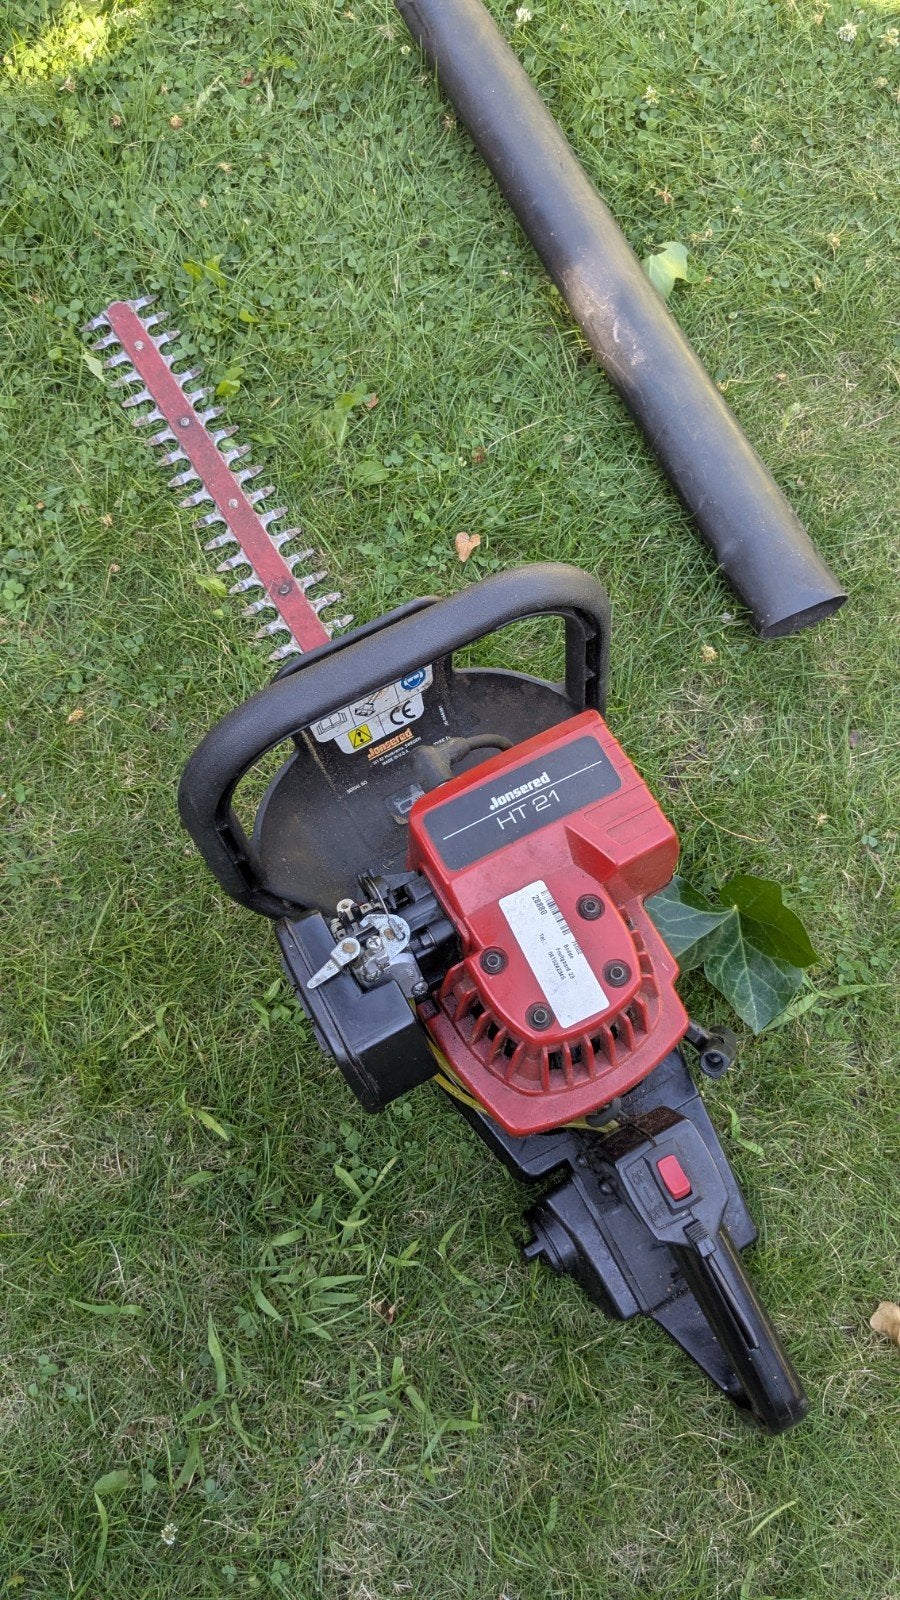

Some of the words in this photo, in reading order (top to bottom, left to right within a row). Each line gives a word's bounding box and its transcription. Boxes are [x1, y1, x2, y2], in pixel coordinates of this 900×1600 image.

[390, 700, 416, 725] CE
[367, 728, 414, 759] Jonsered
[489, 772, 551, 811] Jonsered
[496, 804, 527, 830] HT
[532, 789, 561, 812] 21
